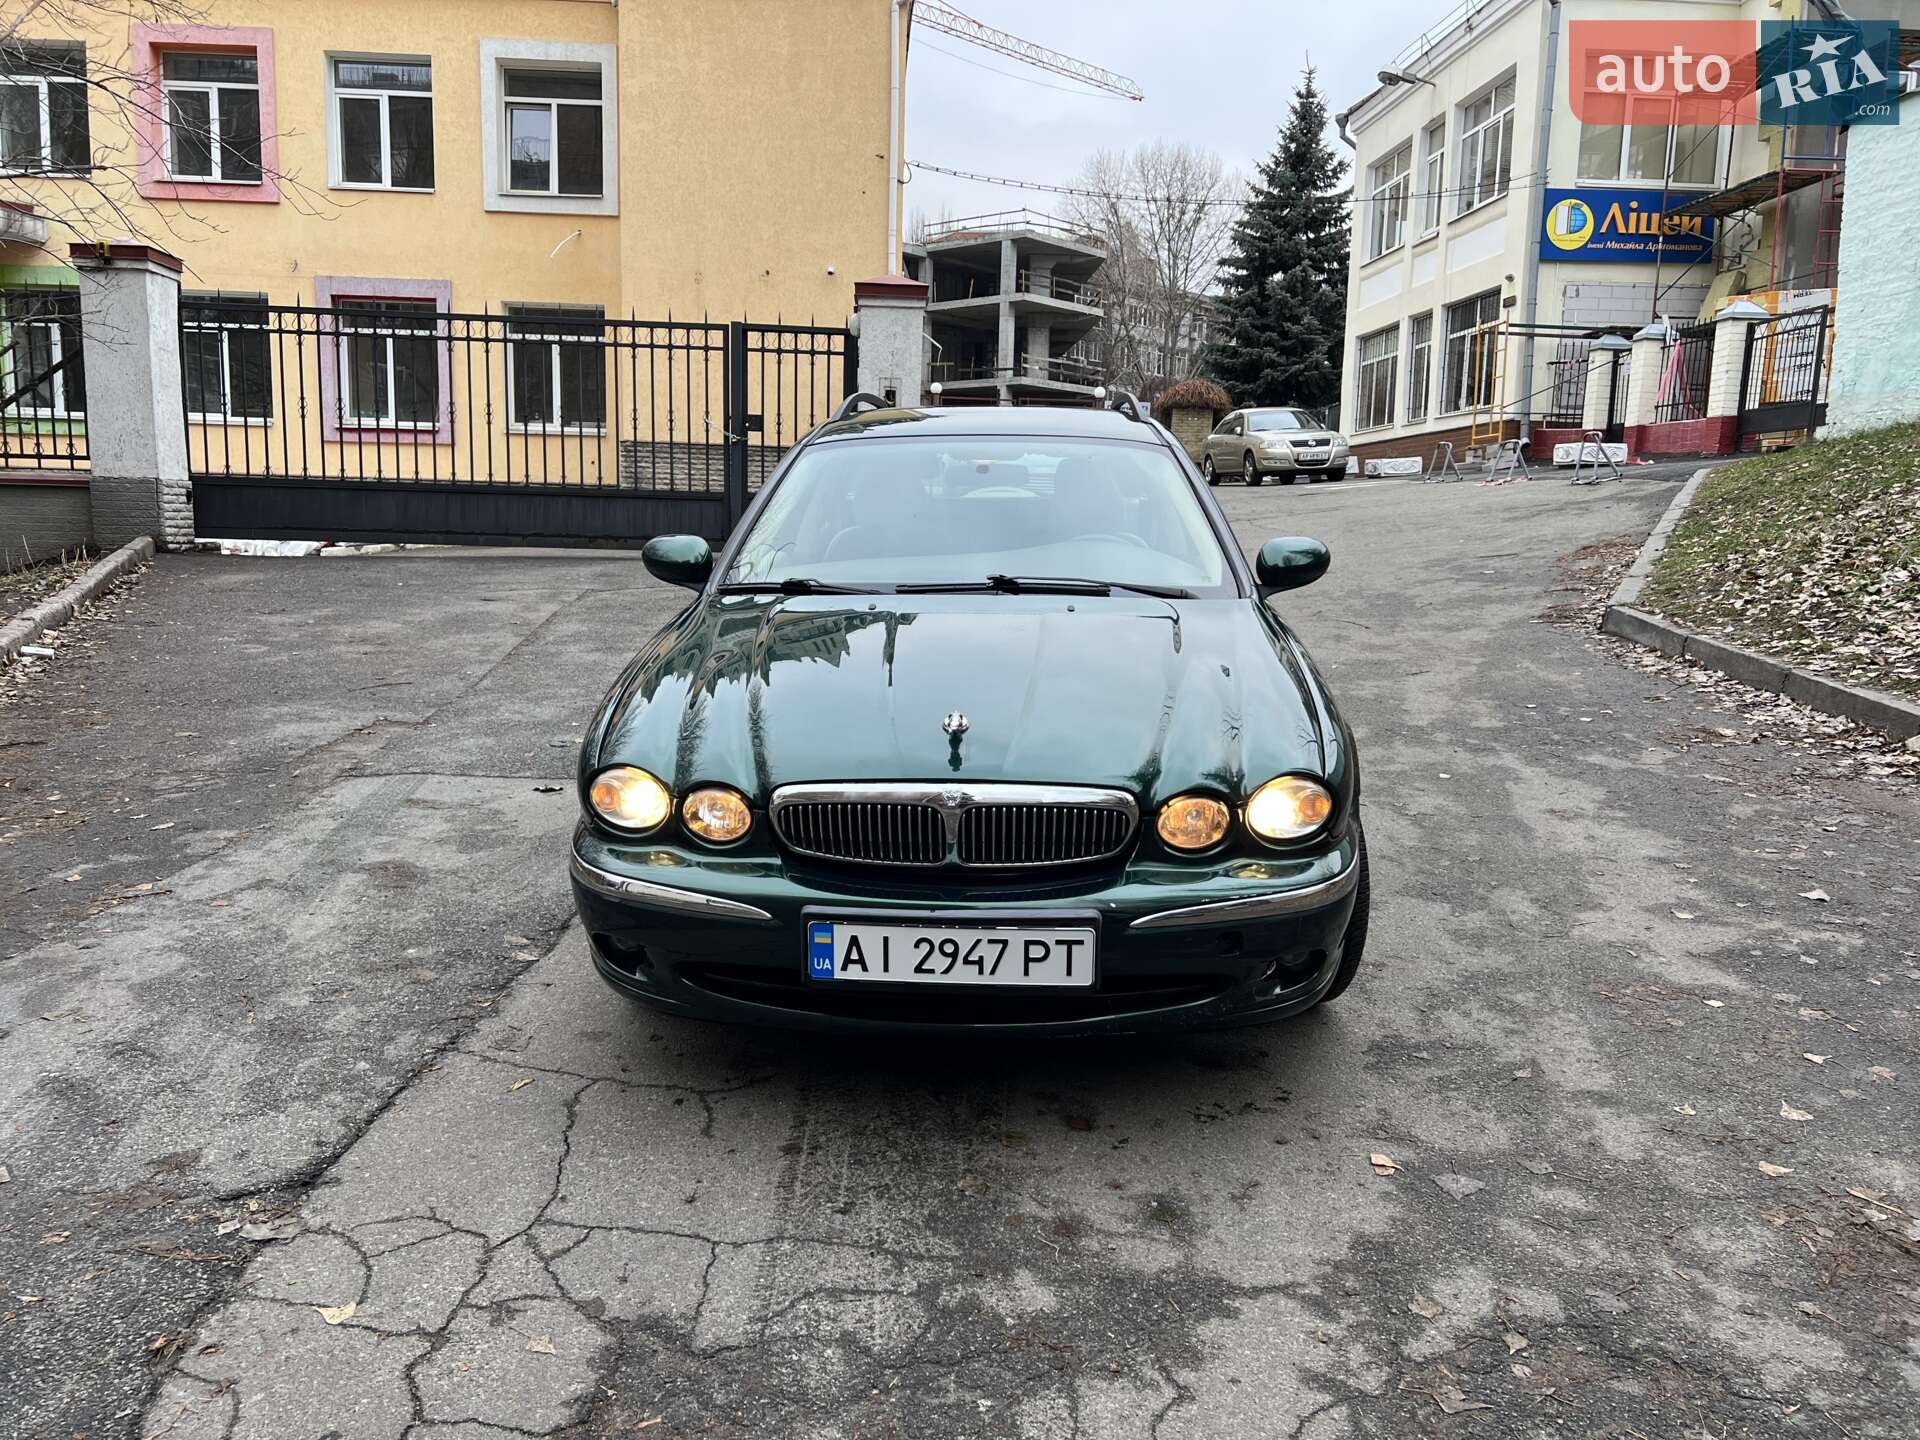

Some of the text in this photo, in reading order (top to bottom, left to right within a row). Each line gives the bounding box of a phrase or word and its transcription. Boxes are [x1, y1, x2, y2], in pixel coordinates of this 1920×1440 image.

[814, 934, 1085, 977] UA AI 2947 PT
